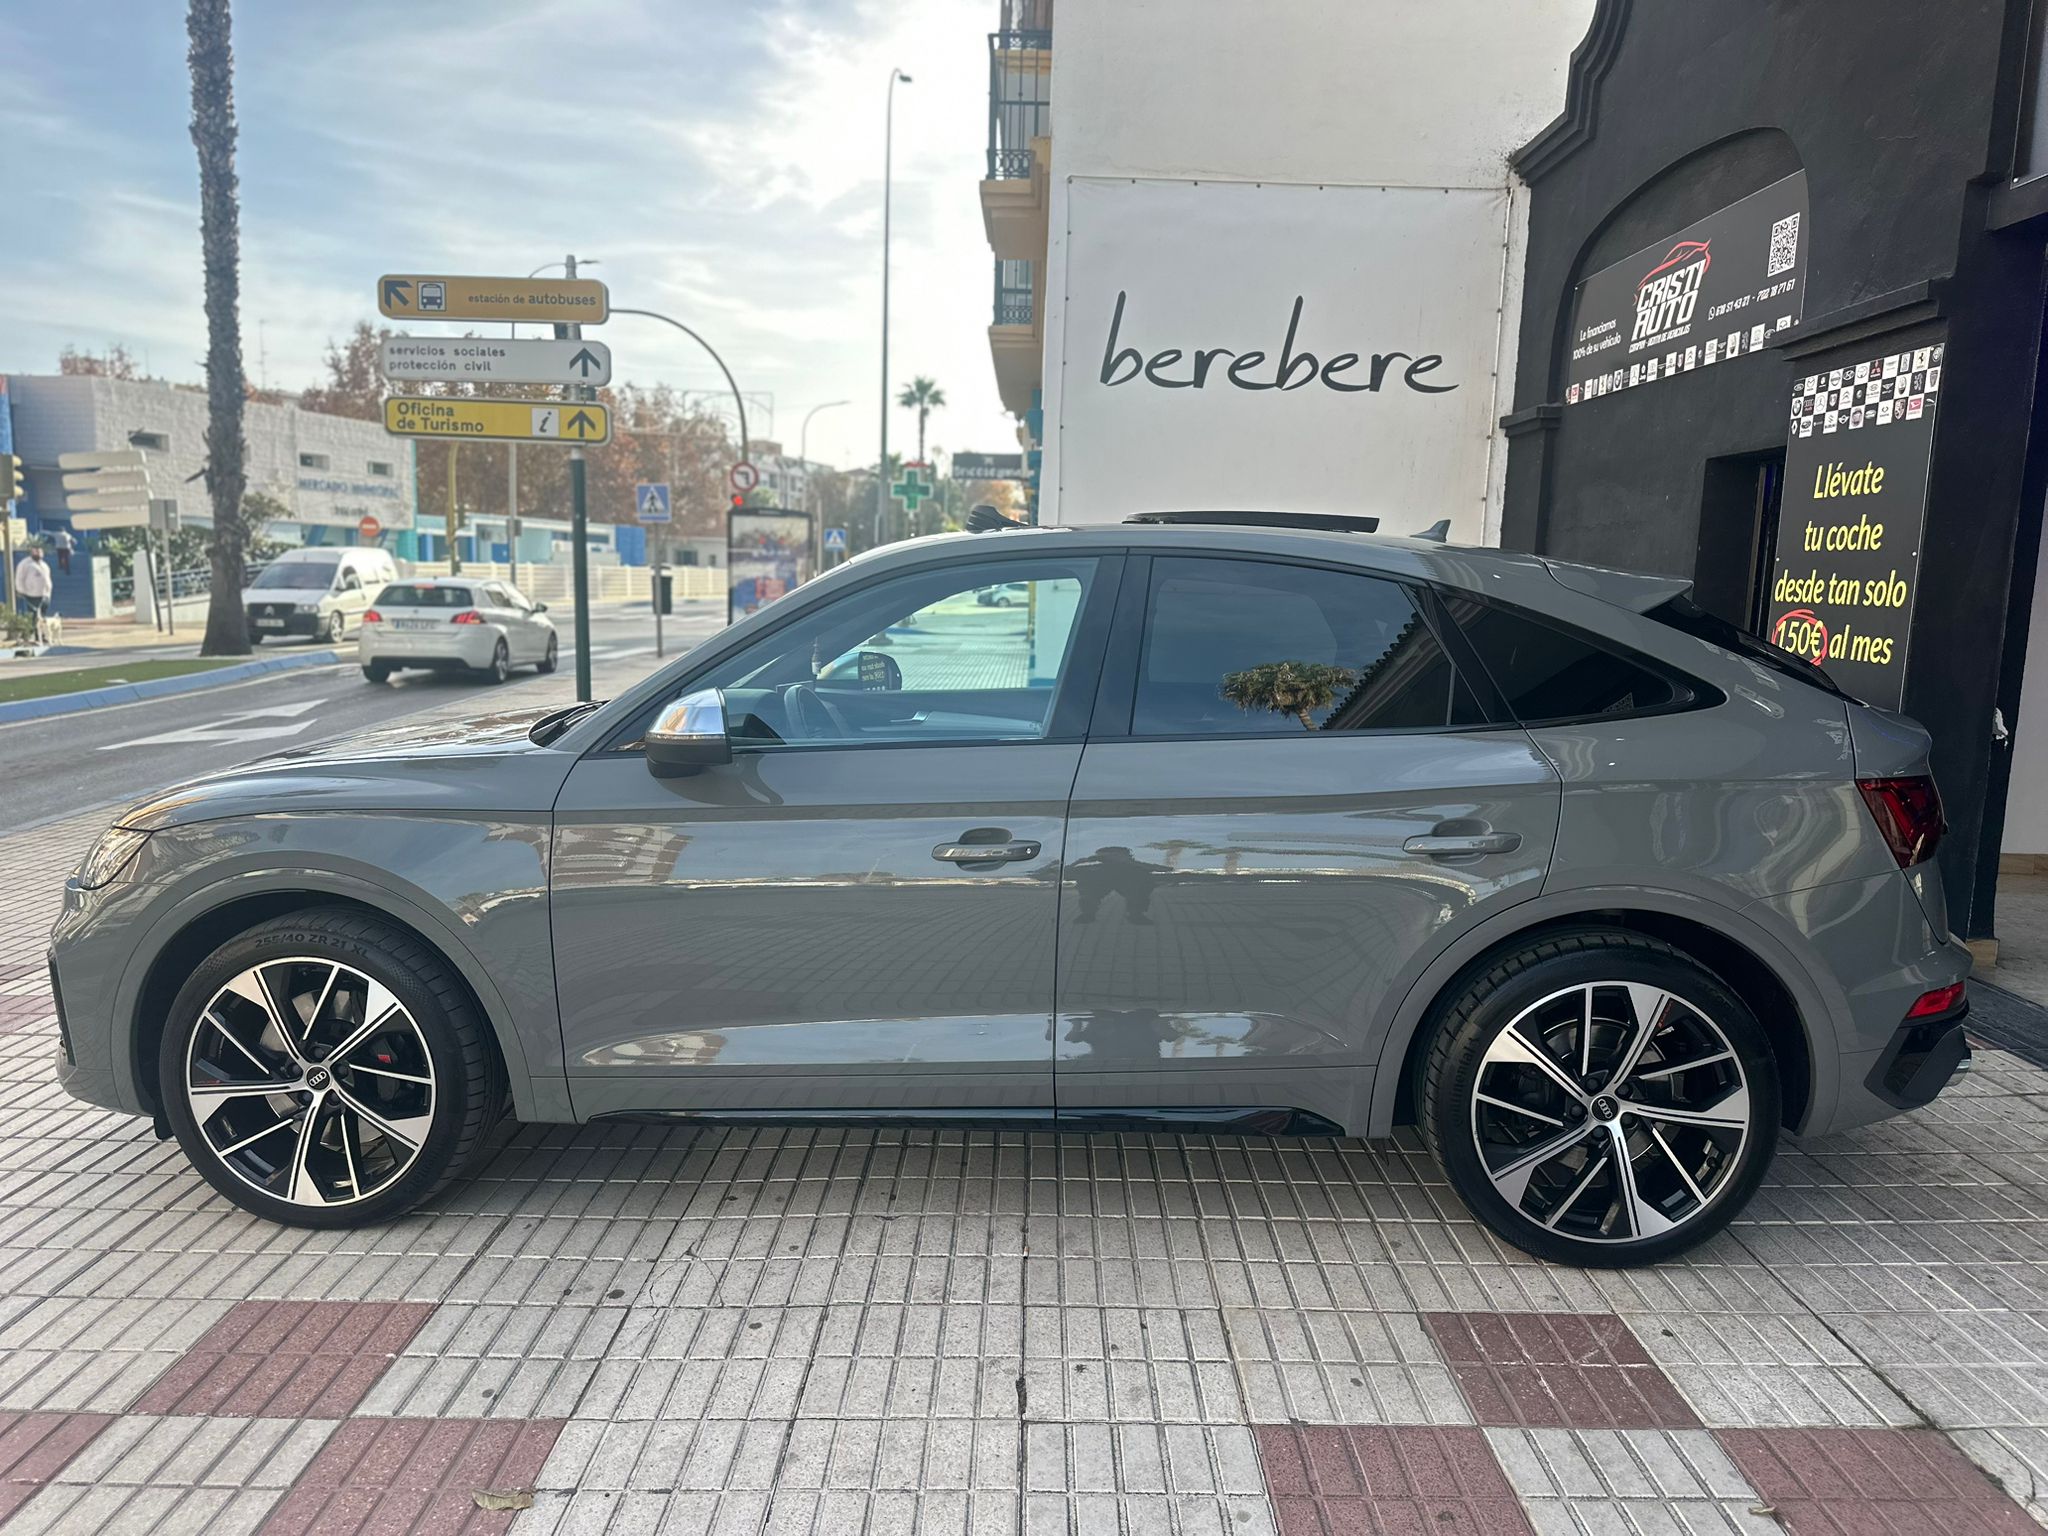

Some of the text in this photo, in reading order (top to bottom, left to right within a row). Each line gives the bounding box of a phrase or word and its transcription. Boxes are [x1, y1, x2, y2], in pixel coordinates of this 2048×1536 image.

[468, 293, 597, 306] estación de autobuses
[1636, 259, 1706, 313] CRISTI
[1631, 290, 1698, 341] AUTO
[389, 345, 506, 357] servicios sociales
[1100, 290, 1460, 393] berebere
[389, 359, 491, 372] protección civil
[397, 402, 454, 417] Oficina
[397, 417, 484, 432] de Turismo
[1814, 461, 1885, 499] Llévate
[1804, 514, 1884, 551] tu coche
[1775, 569, 1907, 608] desde tan solo
[1776, 620, 1894, 665] 150€ al mes
[255, 933, 369, 959] 255/40 ZR 21 XL
